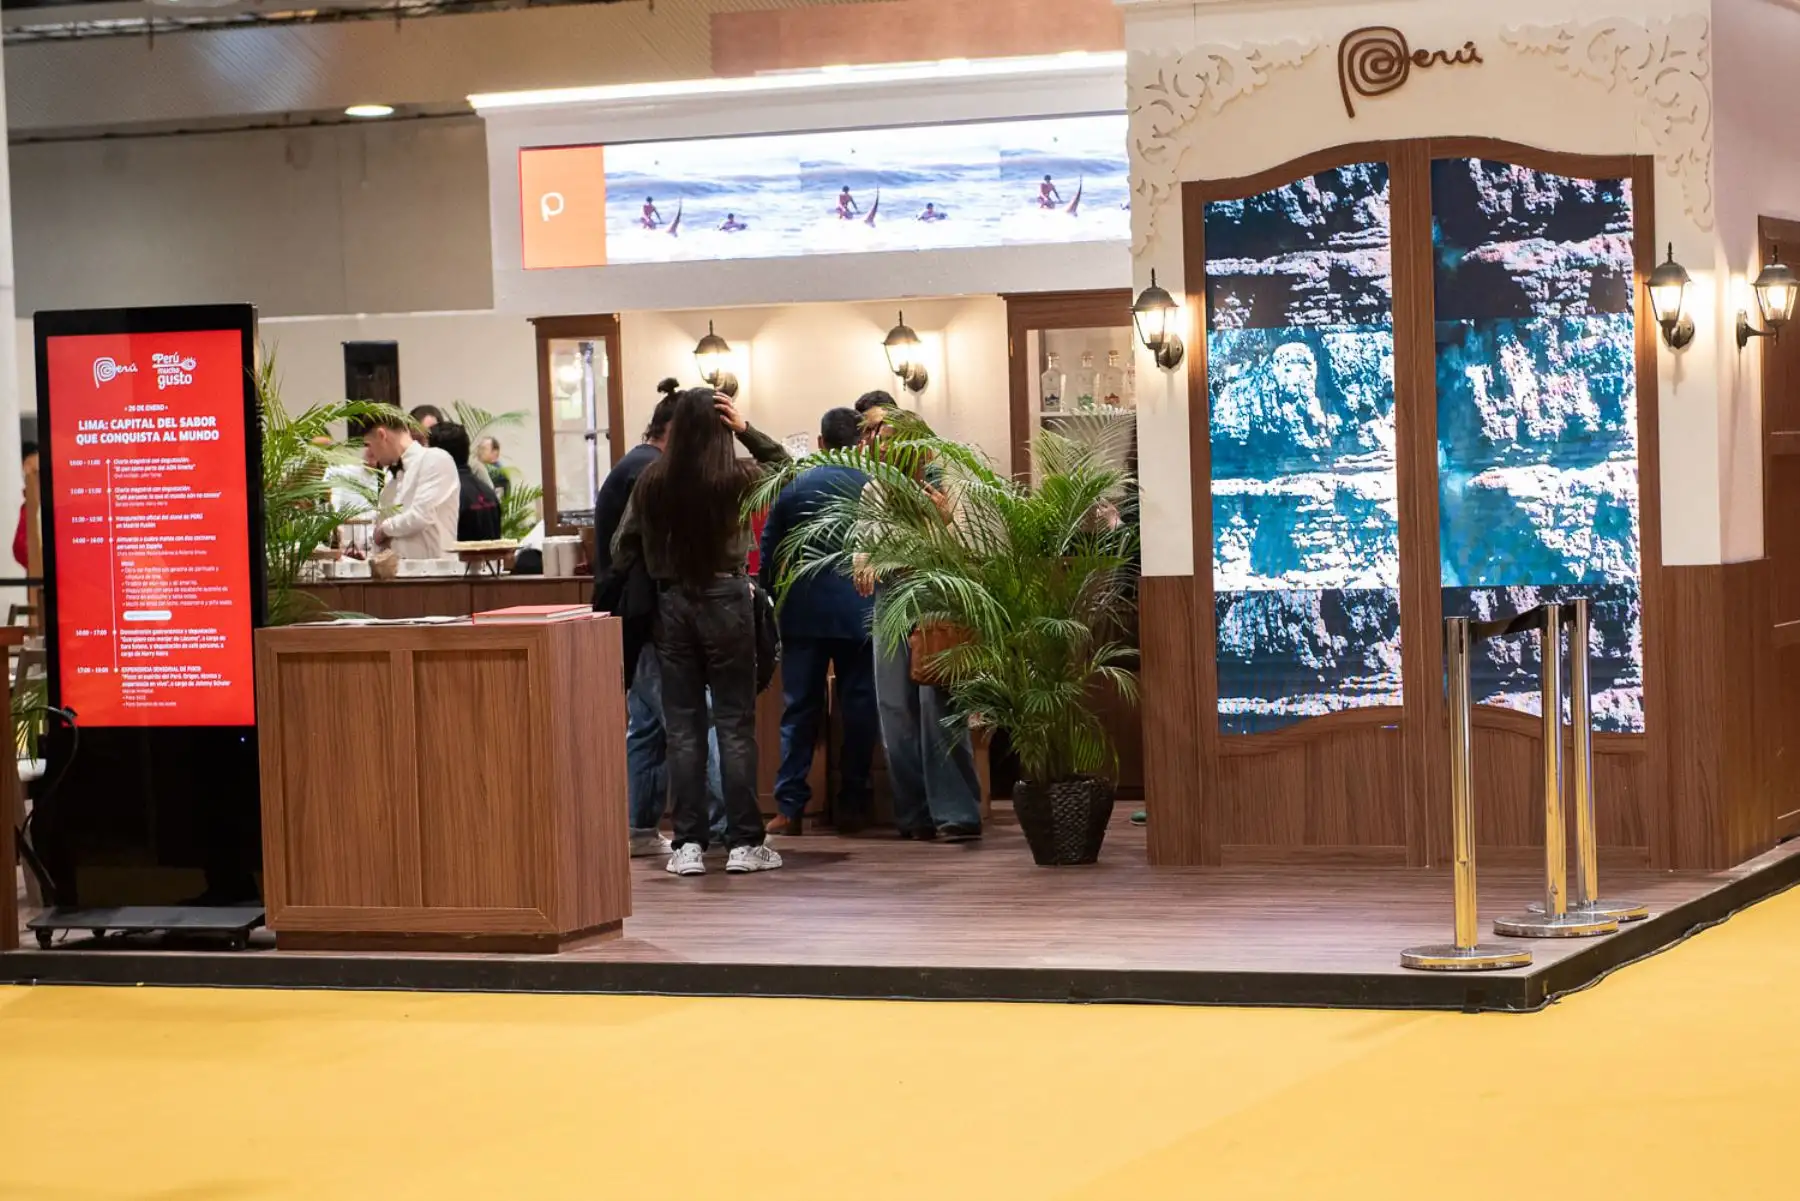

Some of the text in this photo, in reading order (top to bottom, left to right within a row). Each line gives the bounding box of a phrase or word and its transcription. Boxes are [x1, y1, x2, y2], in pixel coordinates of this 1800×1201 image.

[1338, 26, 1483, 118] Perú
[152, 352, 179, 364] Perú
[93, 356, 138, 388] Perú
[157, 371, 193, 390] gusto
[78, 416, 216, 431] LIMA: CAPITAL DEL SABOR
[76, 430, 219, 445] QUE CONQUISTA AL MUNDO
